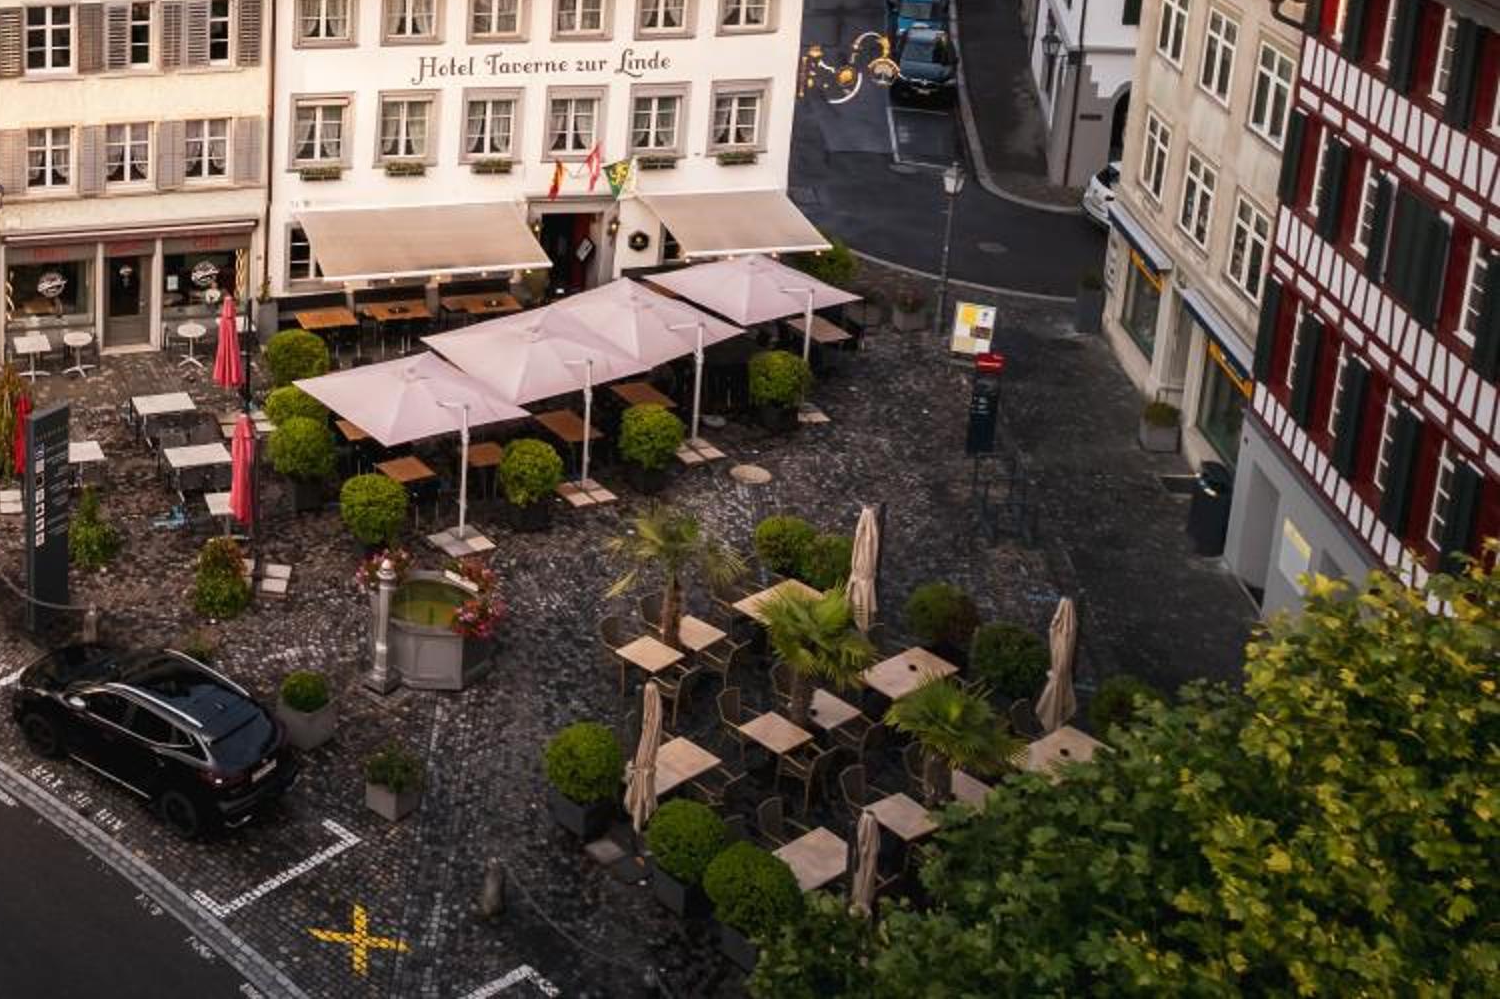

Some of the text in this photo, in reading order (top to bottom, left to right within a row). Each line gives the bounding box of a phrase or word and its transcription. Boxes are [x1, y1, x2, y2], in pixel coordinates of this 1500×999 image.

[411, 48, 671, 85] Hotel Taverne zur Linde
